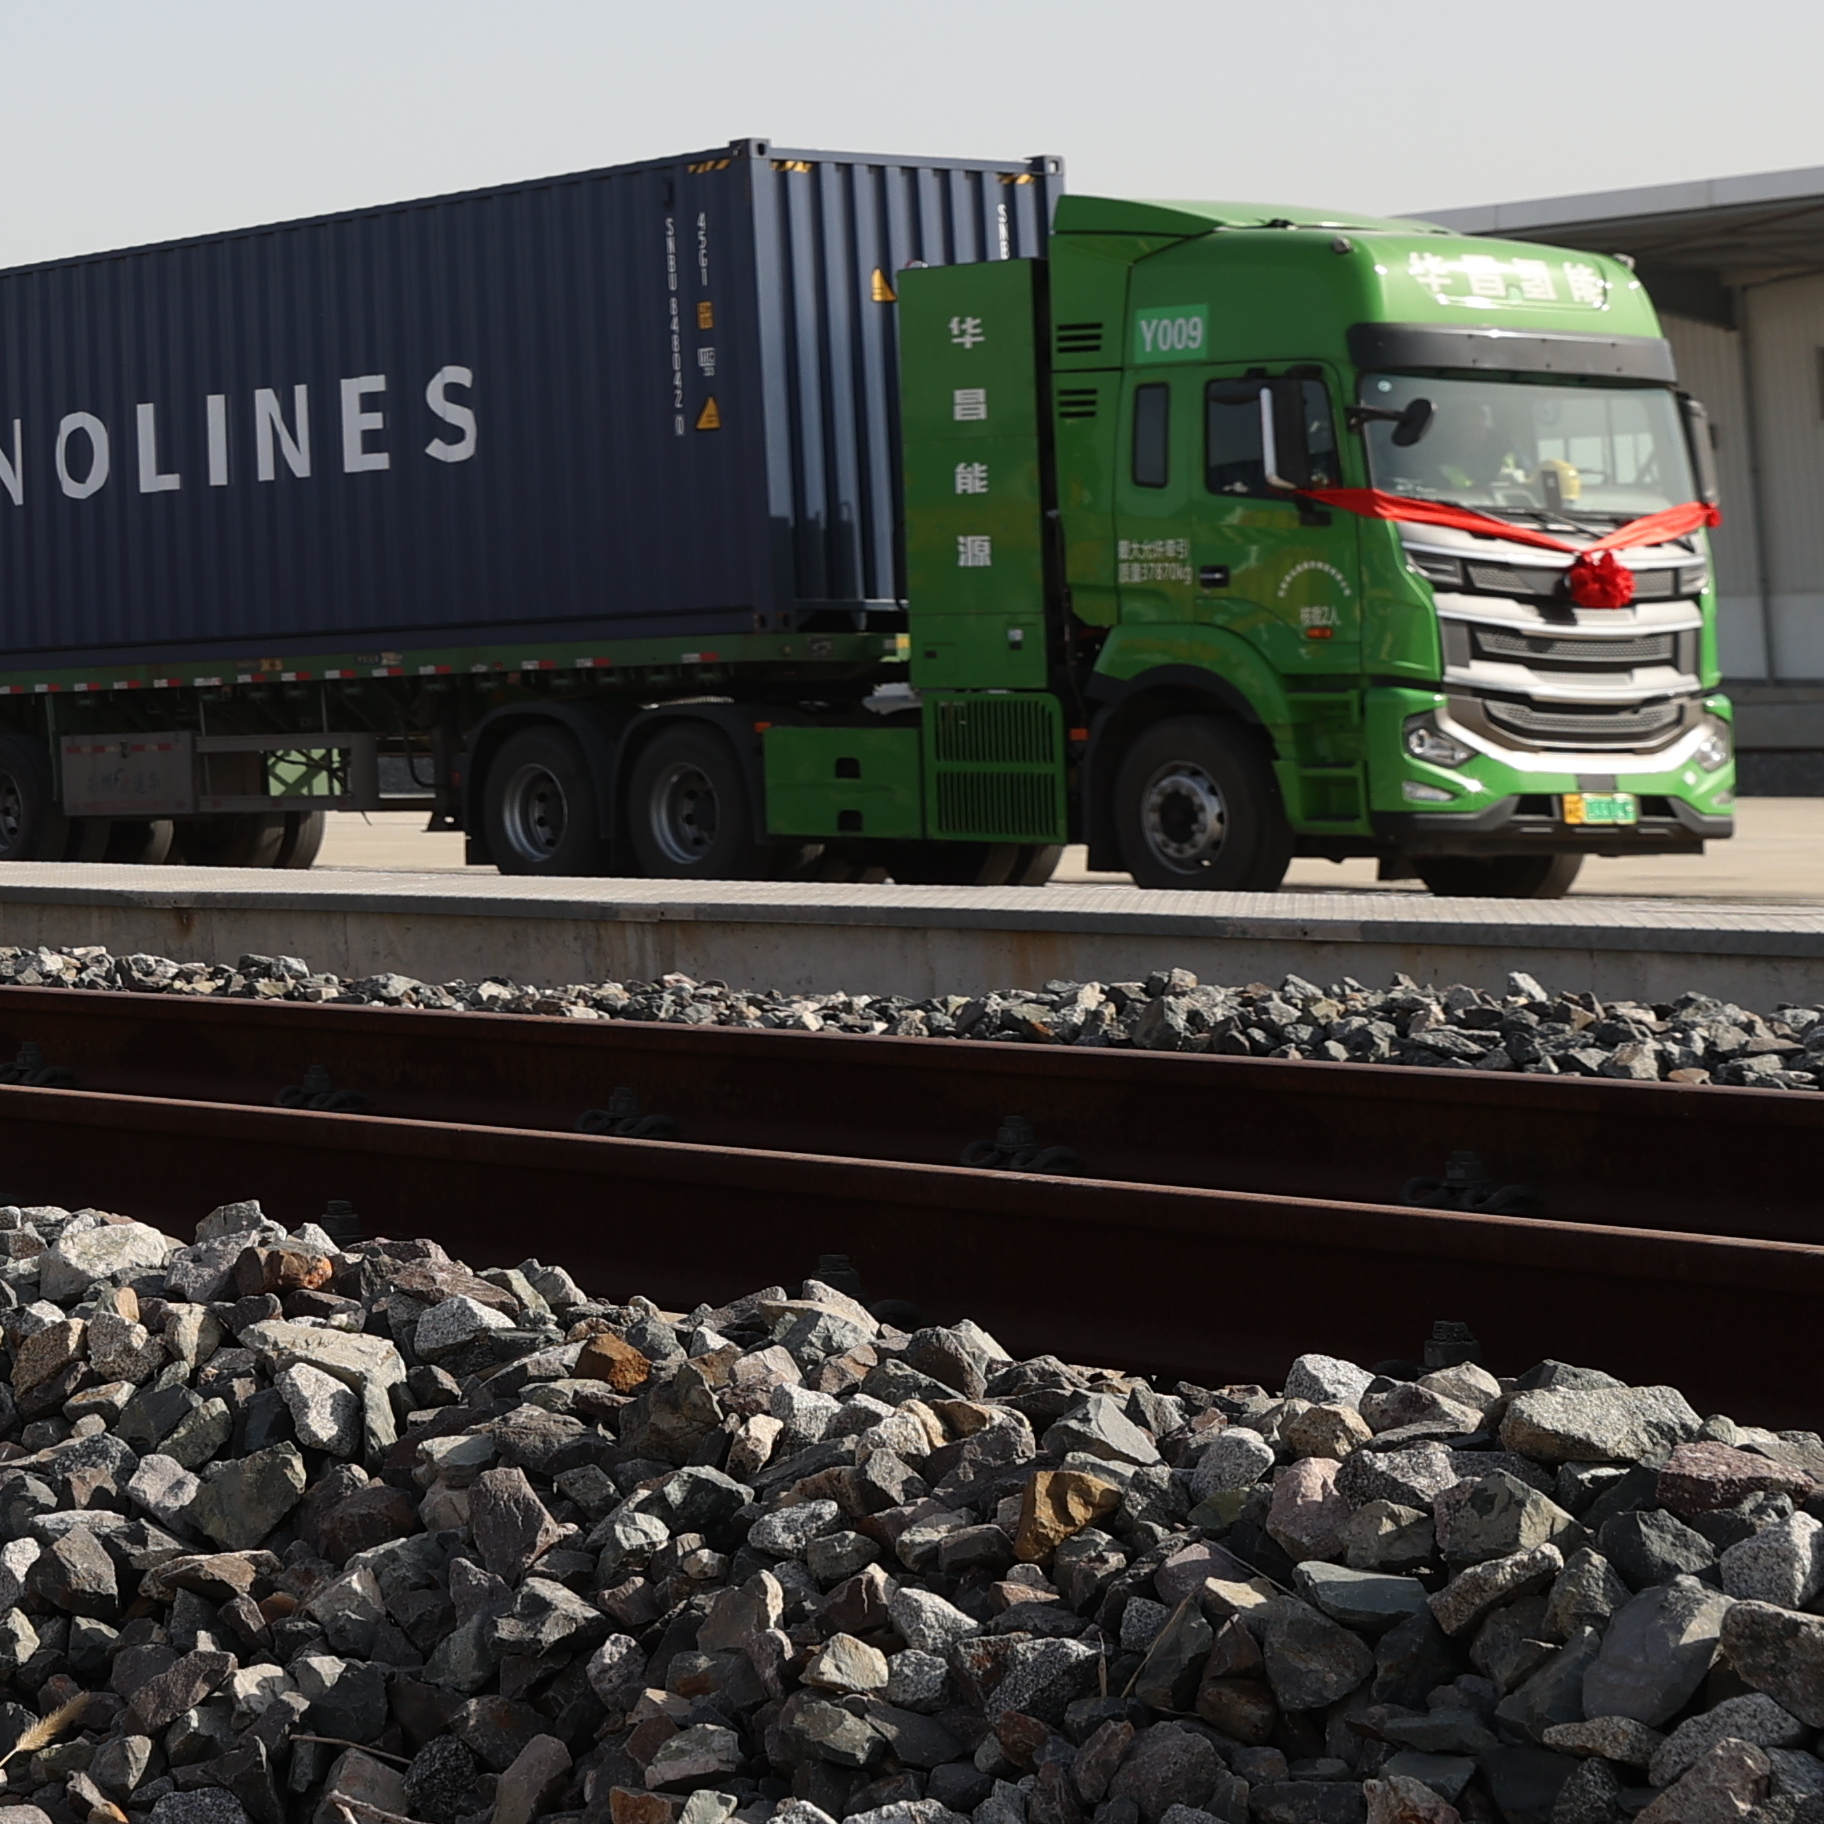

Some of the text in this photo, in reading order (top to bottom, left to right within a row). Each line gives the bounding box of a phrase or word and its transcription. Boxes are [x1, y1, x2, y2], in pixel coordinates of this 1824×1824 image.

[1140, 316, 1204, 352] Y009
[948, 316, 993, 567] 华昌能源
